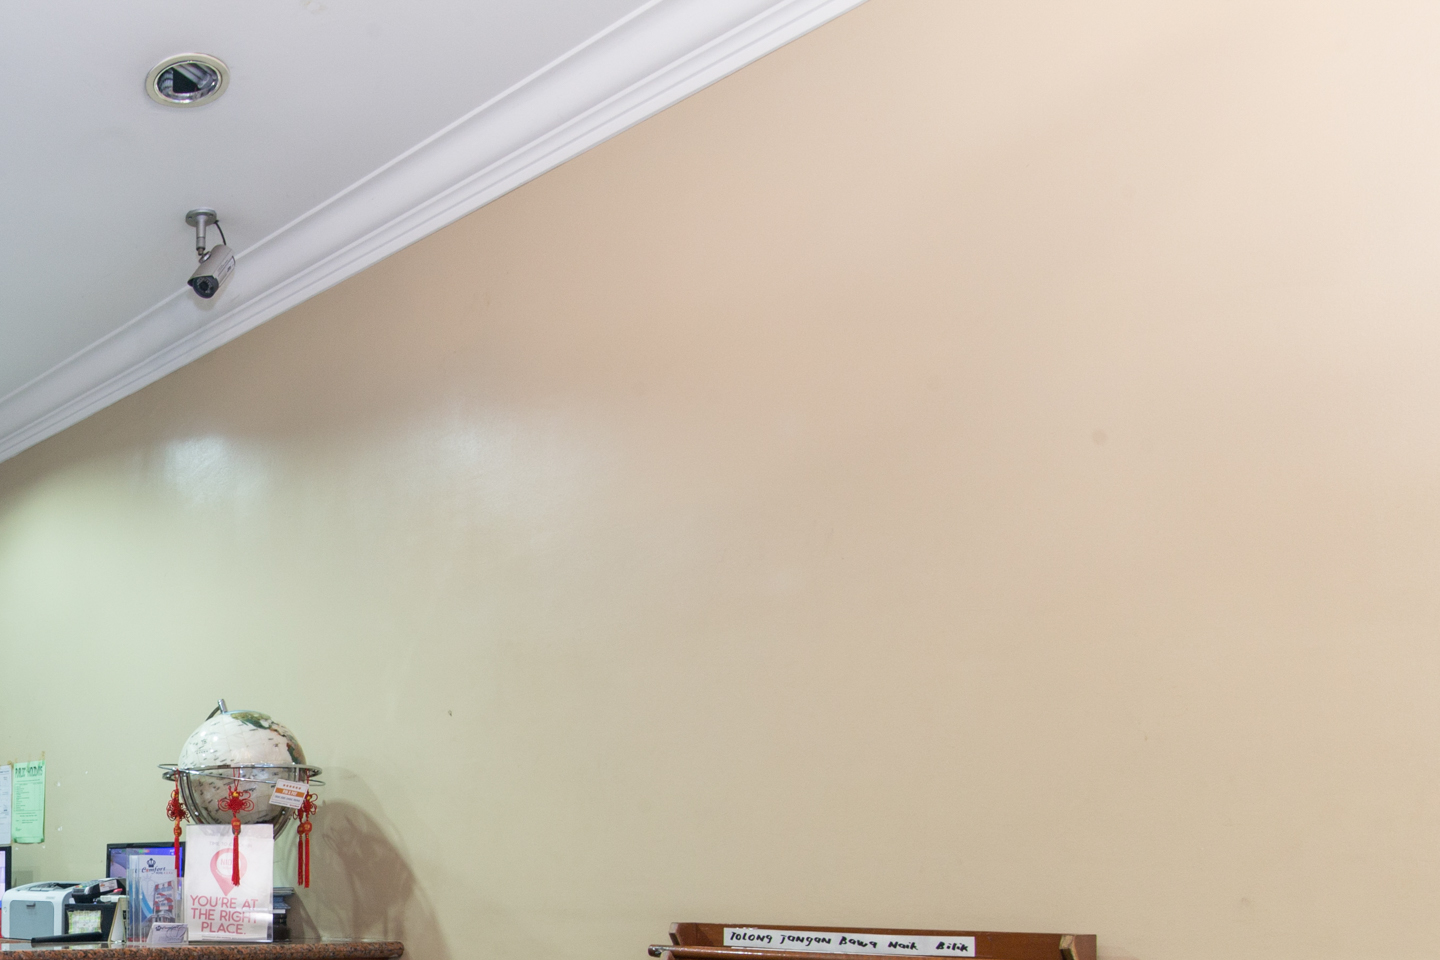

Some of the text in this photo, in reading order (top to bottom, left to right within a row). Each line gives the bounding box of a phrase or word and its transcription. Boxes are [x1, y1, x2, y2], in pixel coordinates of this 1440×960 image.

[190, 894, 258, 910] YOU'RE AT
[190, 908, 216, 921] THE
[201, 922, 247, 936] PLACE.
